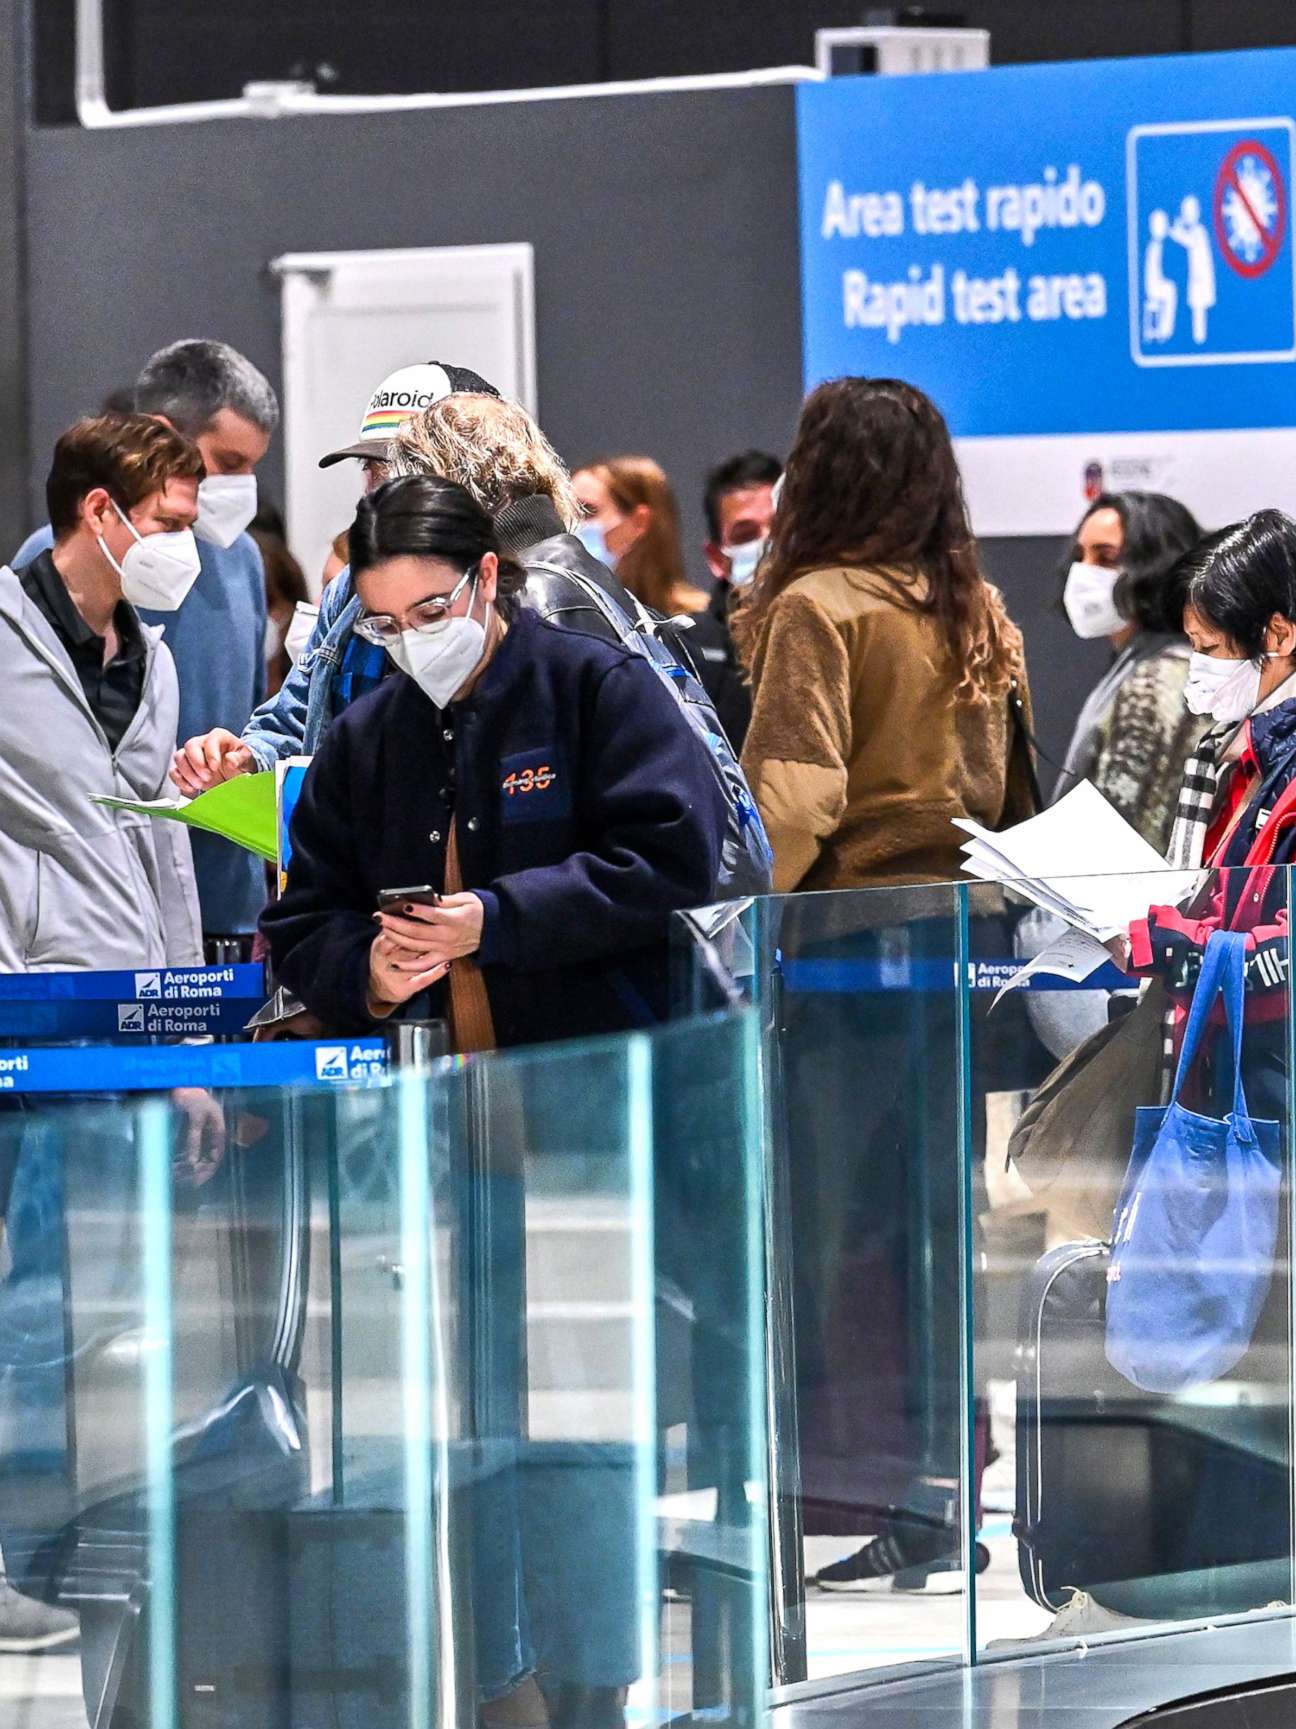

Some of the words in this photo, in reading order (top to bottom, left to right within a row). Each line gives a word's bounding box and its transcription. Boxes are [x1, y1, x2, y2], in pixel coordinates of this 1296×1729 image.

[821, 179, 904, 240] Area
[911, 177, 979, 235] test
[986, 163, 1105, 248] rapido
[843, 263, 945, 345] Rapid
[953, 267, 1021, 325] test
[1027, 272, 1107, 321] area
[370, 390, 434, 409] olaroid
[164, 968, 234, 985] Aeroporti
[978, 976, 990, 988] di
[139, 989, 159, 998] ADR
[164, 985, 179, 999] di
[180, 984, 222, 999] Roma
[147, 1003, 221, 1019] Aeroporti
[147, 1019, 161, 1031] di
[164, 1019, 207, 1032] Roma
